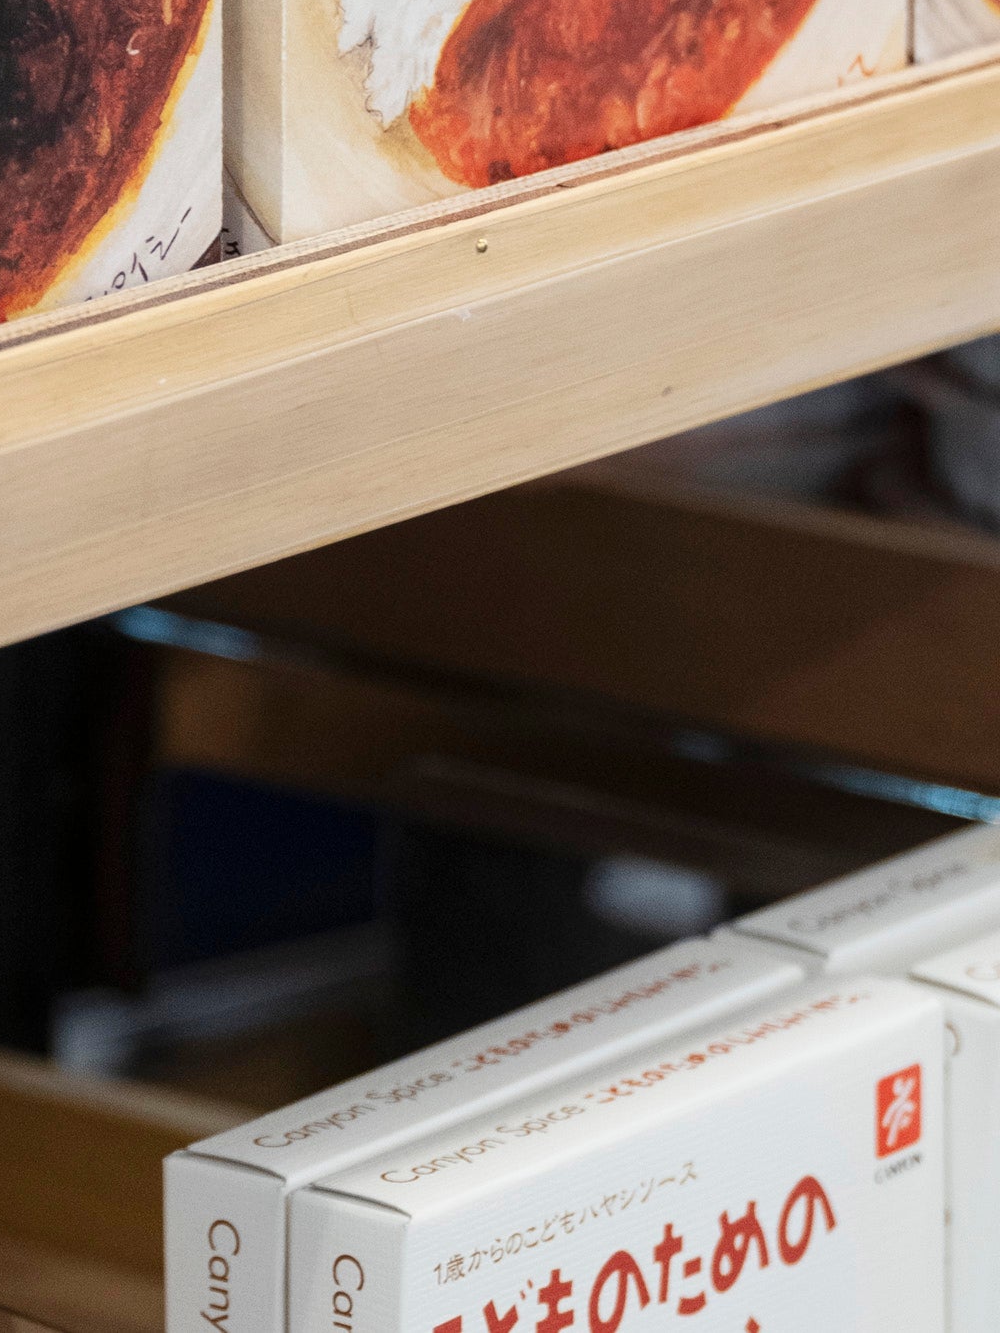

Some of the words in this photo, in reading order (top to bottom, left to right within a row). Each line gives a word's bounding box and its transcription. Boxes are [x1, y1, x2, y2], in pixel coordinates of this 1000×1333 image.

[380, 1135, 506, 1184] Canyon
[497, 1102, 585, 1140] Spice
[433, 1161, 698, 1285] 1歳からのこどもハヤシソース
